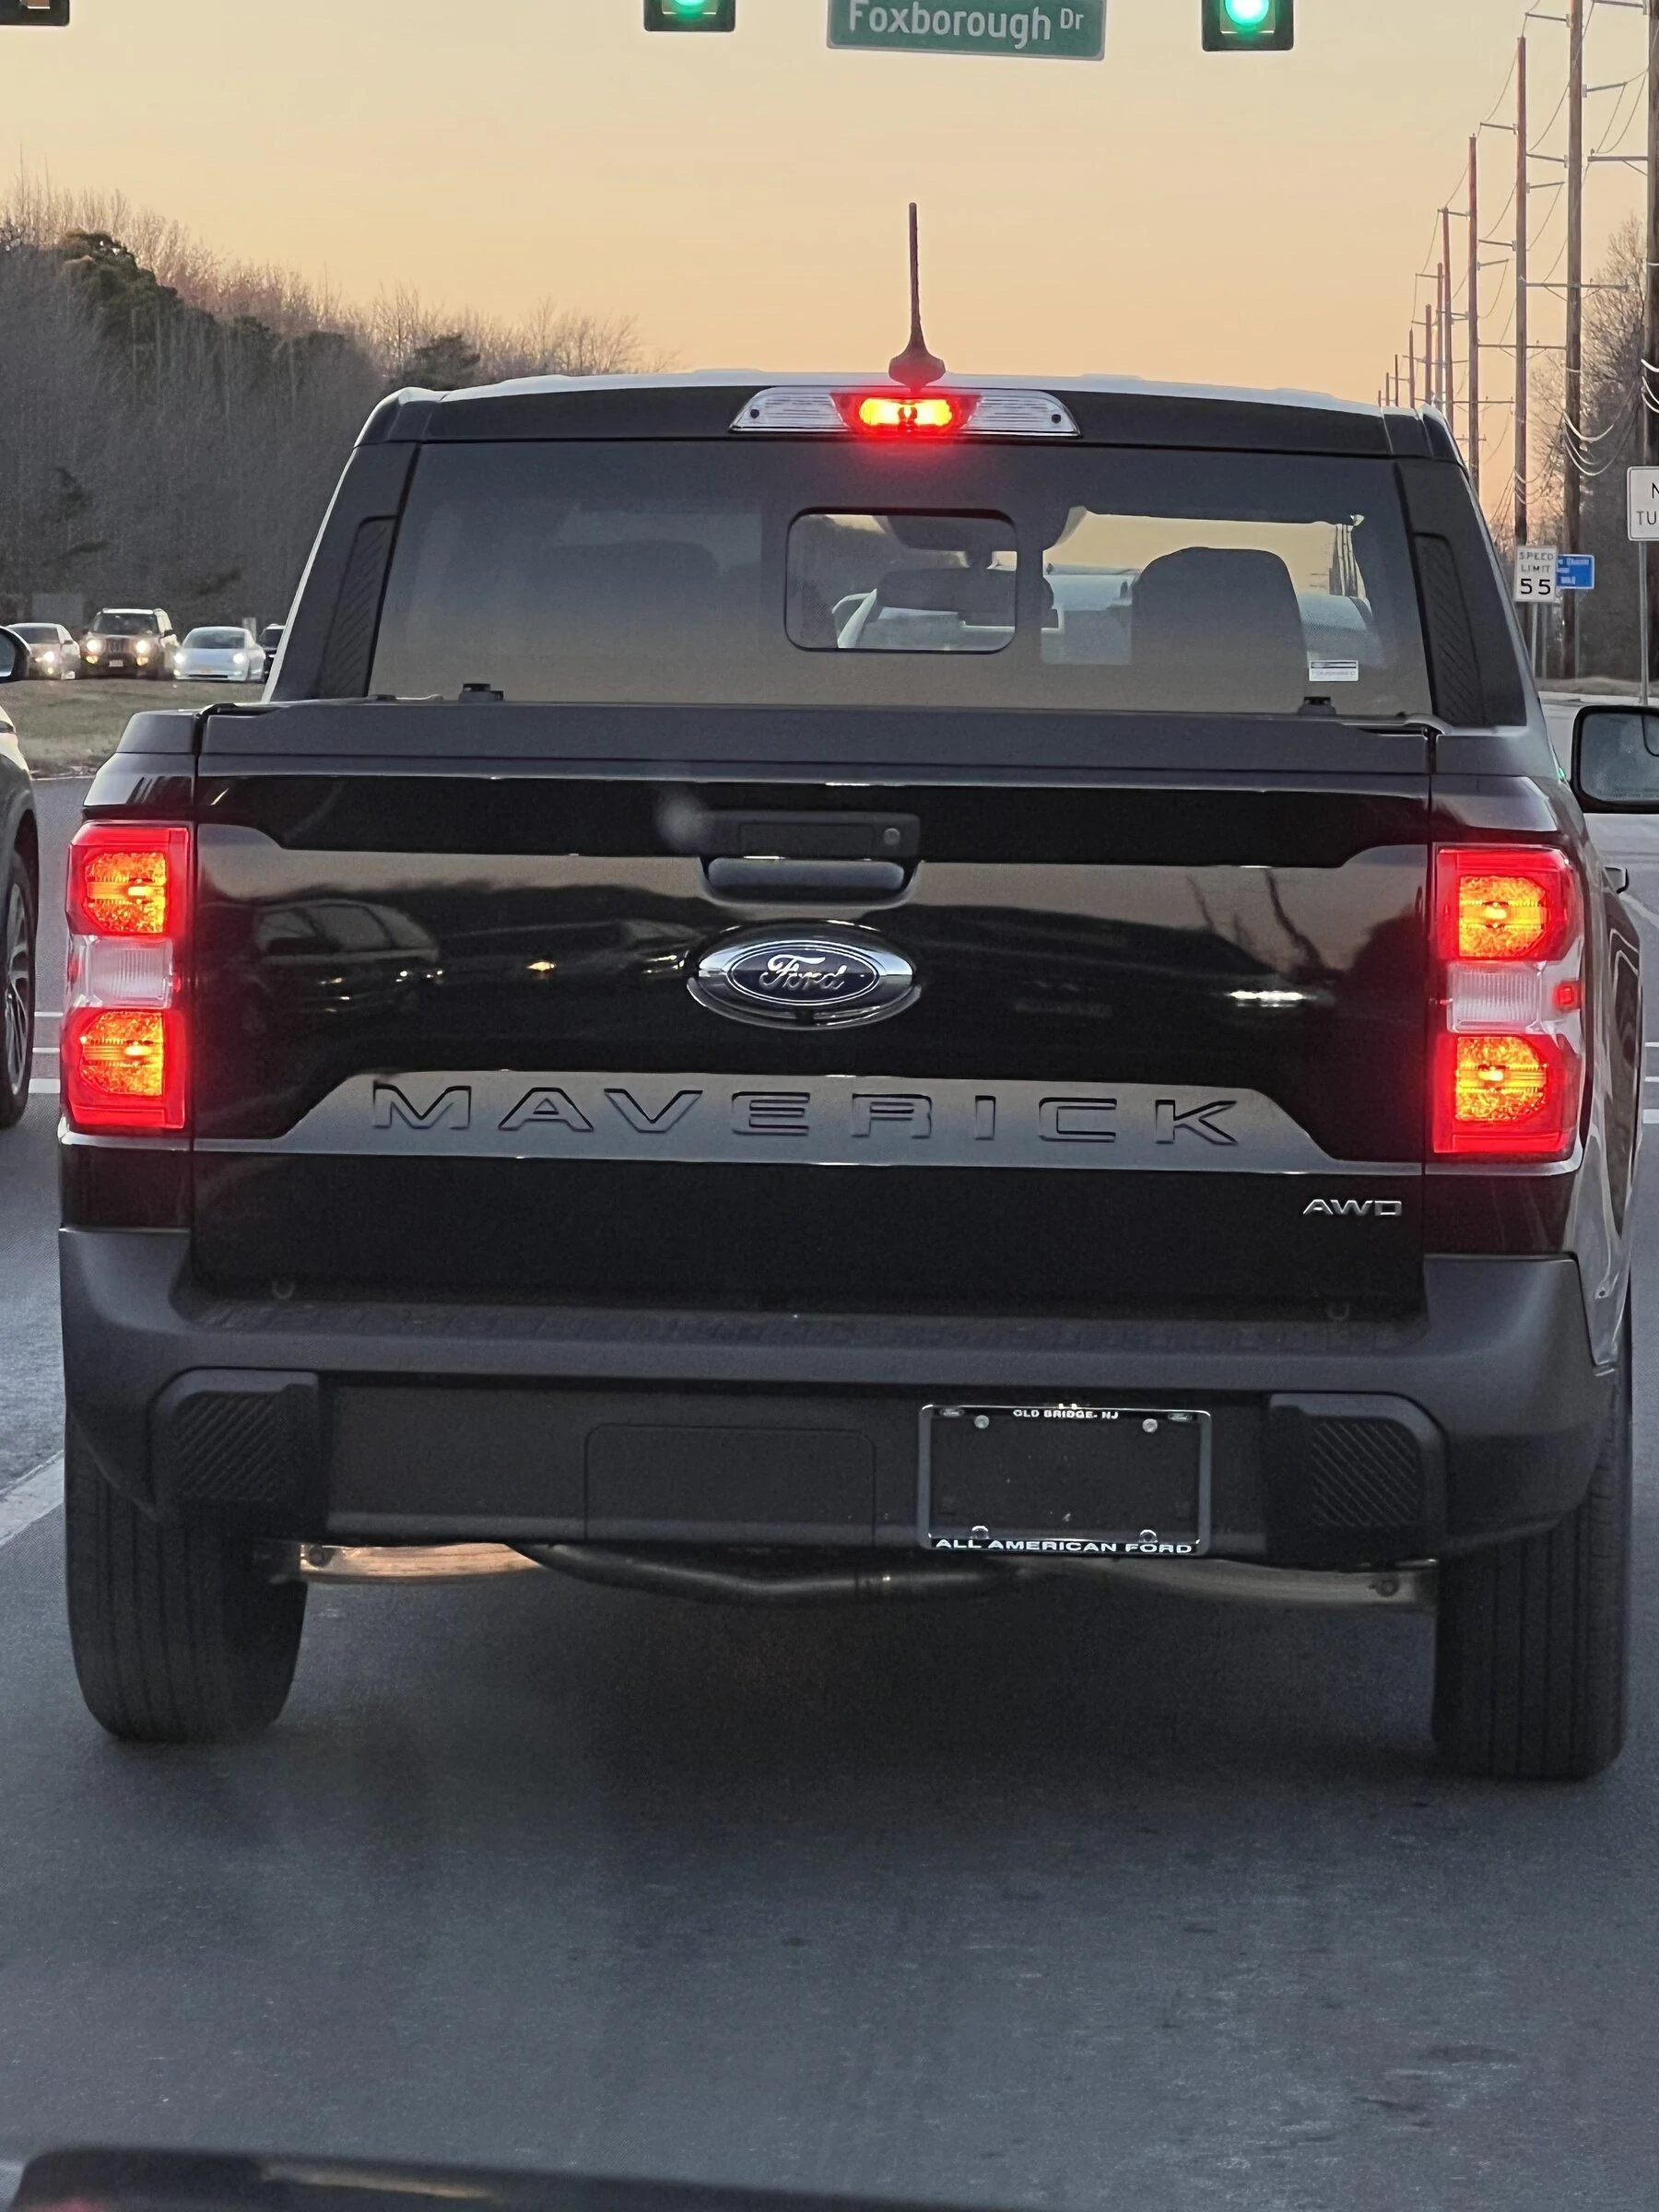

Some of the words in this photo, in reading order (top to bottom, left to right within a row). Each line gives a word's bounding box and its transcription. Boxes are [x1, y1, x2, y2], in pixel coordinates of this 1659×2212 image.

[849, 0, 1052, 49] Foxborough
[1060, 7, 1084, 29] Dr
[1519, 551, 1554, 560] SPEED
[1521, 564, 1550, 572] LIMIT
[1520, 578, 1551, 594] 55
[759, 954, 847, 990] Ford
[372, 1081, 1238, 1145] MAVERICK
[1302, 1198, 1402, 1217] AWD
[1013, 1409, 1040, 1418] OLD
[1101, 1411, 1119, 1419] NJ
[935, 1538, 982, 1548] ALL
[988, 1540, 1116, 1552] AMERICAN
[1124, 1543, 1192, 1554] FORD
